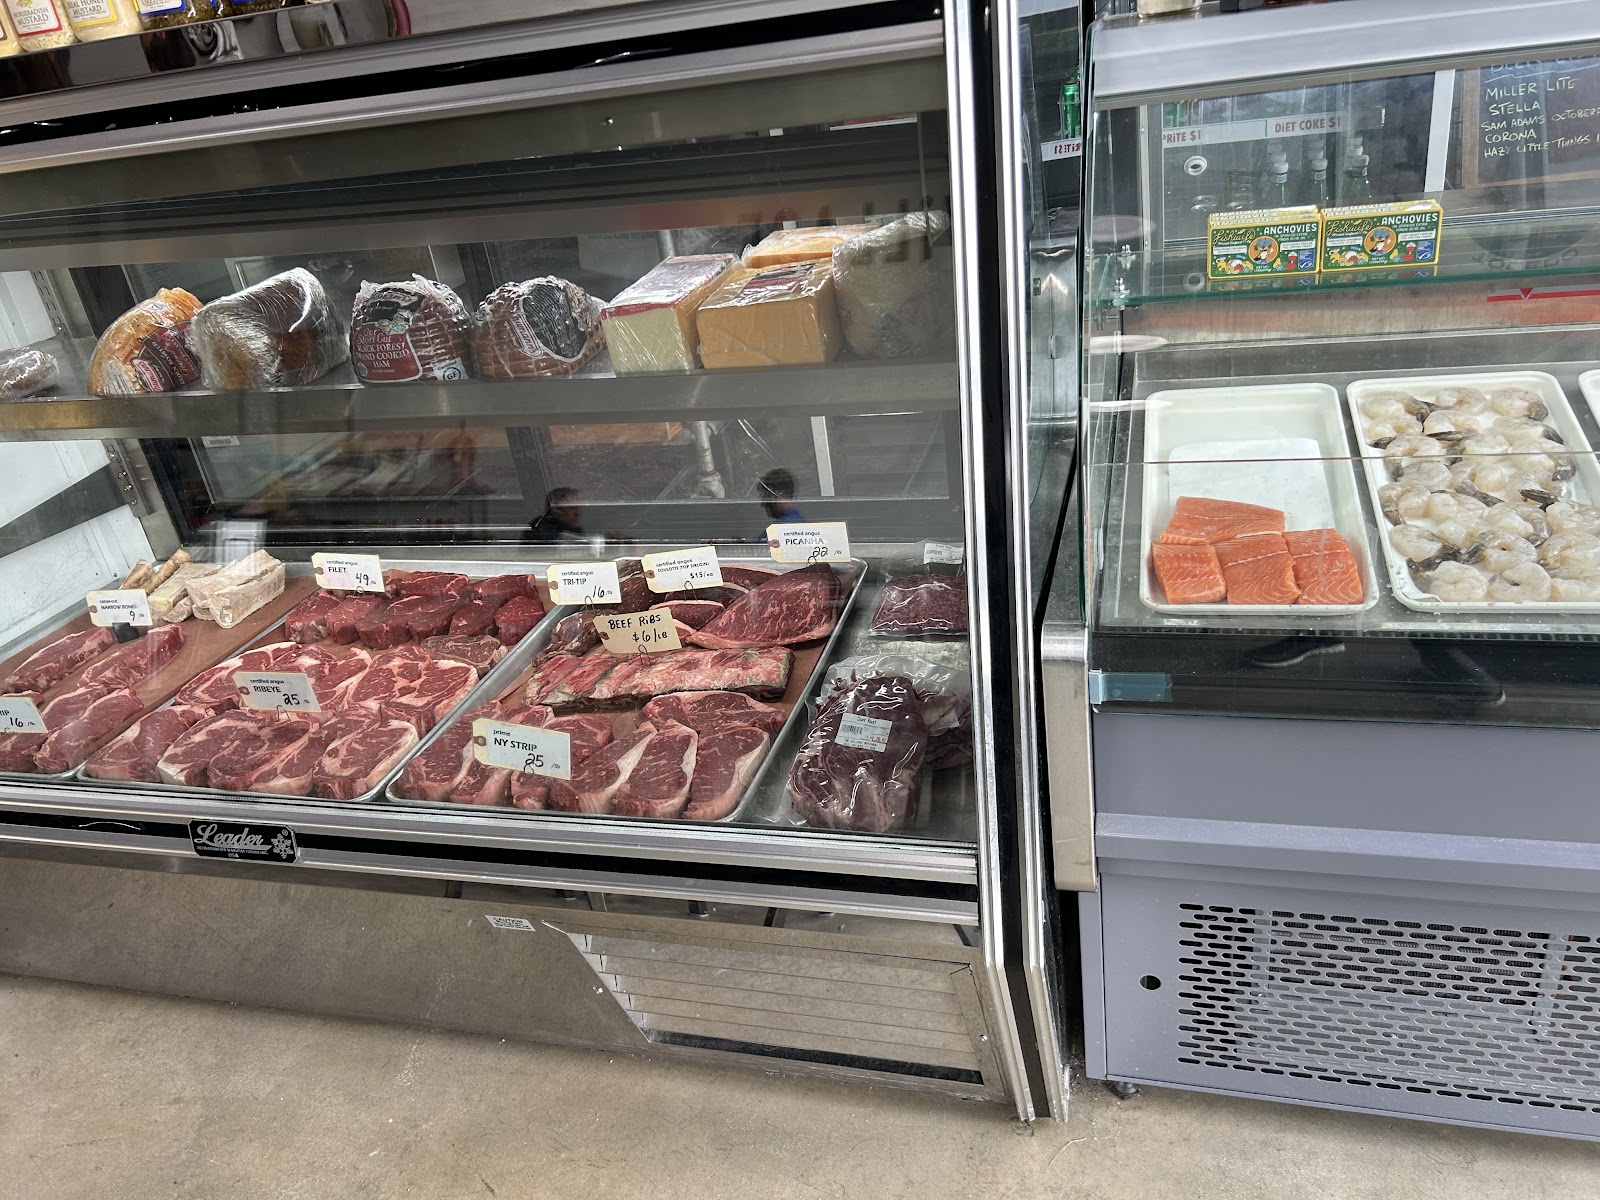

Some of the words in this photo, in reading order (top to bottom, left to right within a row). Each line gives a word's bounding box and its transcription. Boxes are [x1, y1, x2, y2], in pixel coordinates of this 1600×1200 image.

[13, 6, 49, 18] HORSERADISH
[72, 4, 102, 16] MUSTARD
[16, 14, 49, 25] MUSTARD
[1485, 82, 1538, 102] MILLER
[1546, 76, 1577, 91] LITE
[1488, 101, 1541, 116] STELLA
[1298, 118, 1325, 131] COKE
[1327, 116, 1342, 129] $1
[1481, 121, 1507, 132] SAM
[1511, 114, 1546, 128] ADAMS
[1189, 128, 1202, 142] $1
[1485, 128, 1537, 143] CORONA
[1483, 145, 1511, 158] HAZY
[1516, 141, 1550, 153] LITTLE
[1551, 134, 1591, 148] THINGS
[1380, 212, 1439, 226] ANCHOVIES
[1263, 223, 1318, 235] ANCHOVIES
[376, 332, 392, 343] Cut
[376, 342, 406, 352] FOREST
[376, 349, 410, 360] COOKED
[437, 360, 458, 371] Certified
[446, 371, 458, 380] GF
[785, 537, 825, 546] PICANHA
[812, 546, 829, 558] 22
[677, 558, 693, 566] angus
[355, 572, 369, 586] 49
[562, 578, 587, 586] TRI-TIP
[592, 585, 605, 598] 16
[129, 610, 136, 621] 9
[608, 617, 633, 630] BEEF
[253, 685, 282, 693] RIBEYE
[282, 693, 300, 706] 25
[9, 716, 24, 728] 16
[494, 737, 509, 747] NY
[510, 740, 538, 752] STRIP
[525, 753, 544, 767] 25
[194, 823, 266, 848] Leader
